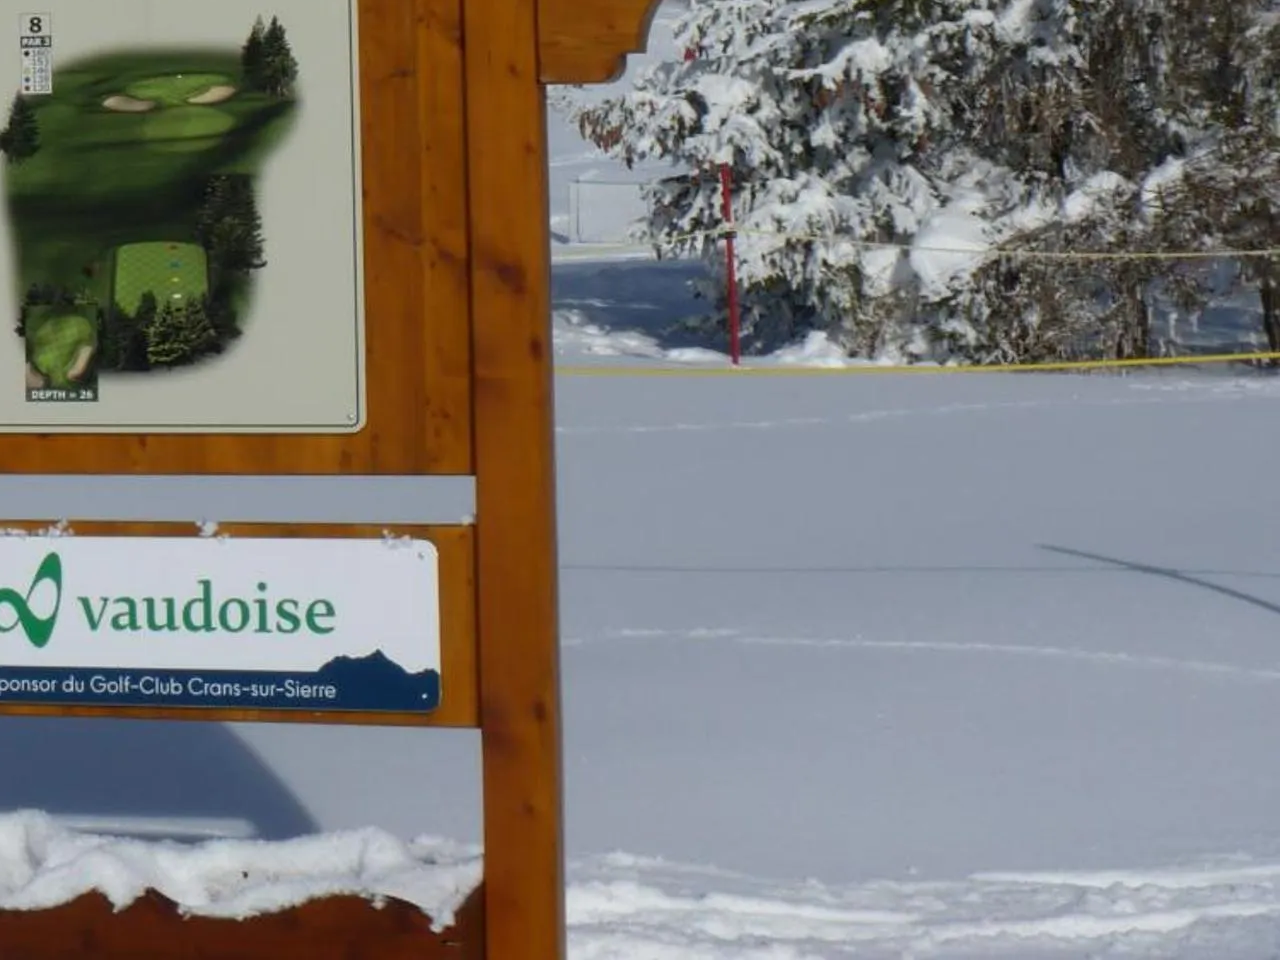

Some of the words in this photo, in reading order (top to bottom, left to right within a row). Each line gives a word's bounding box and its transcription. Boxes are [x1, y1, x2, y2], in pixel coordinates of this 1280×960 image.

[29, 16, 42, 34] 8
[31, 390, 66, 400] DEPTH
[77, 579, 337, 635] vaudoise
[62, 674, 85, 693] du
[89, 675, 183, 696] Golf-Club
[187, 677, 337, 699] Crans-sur-Sierre
